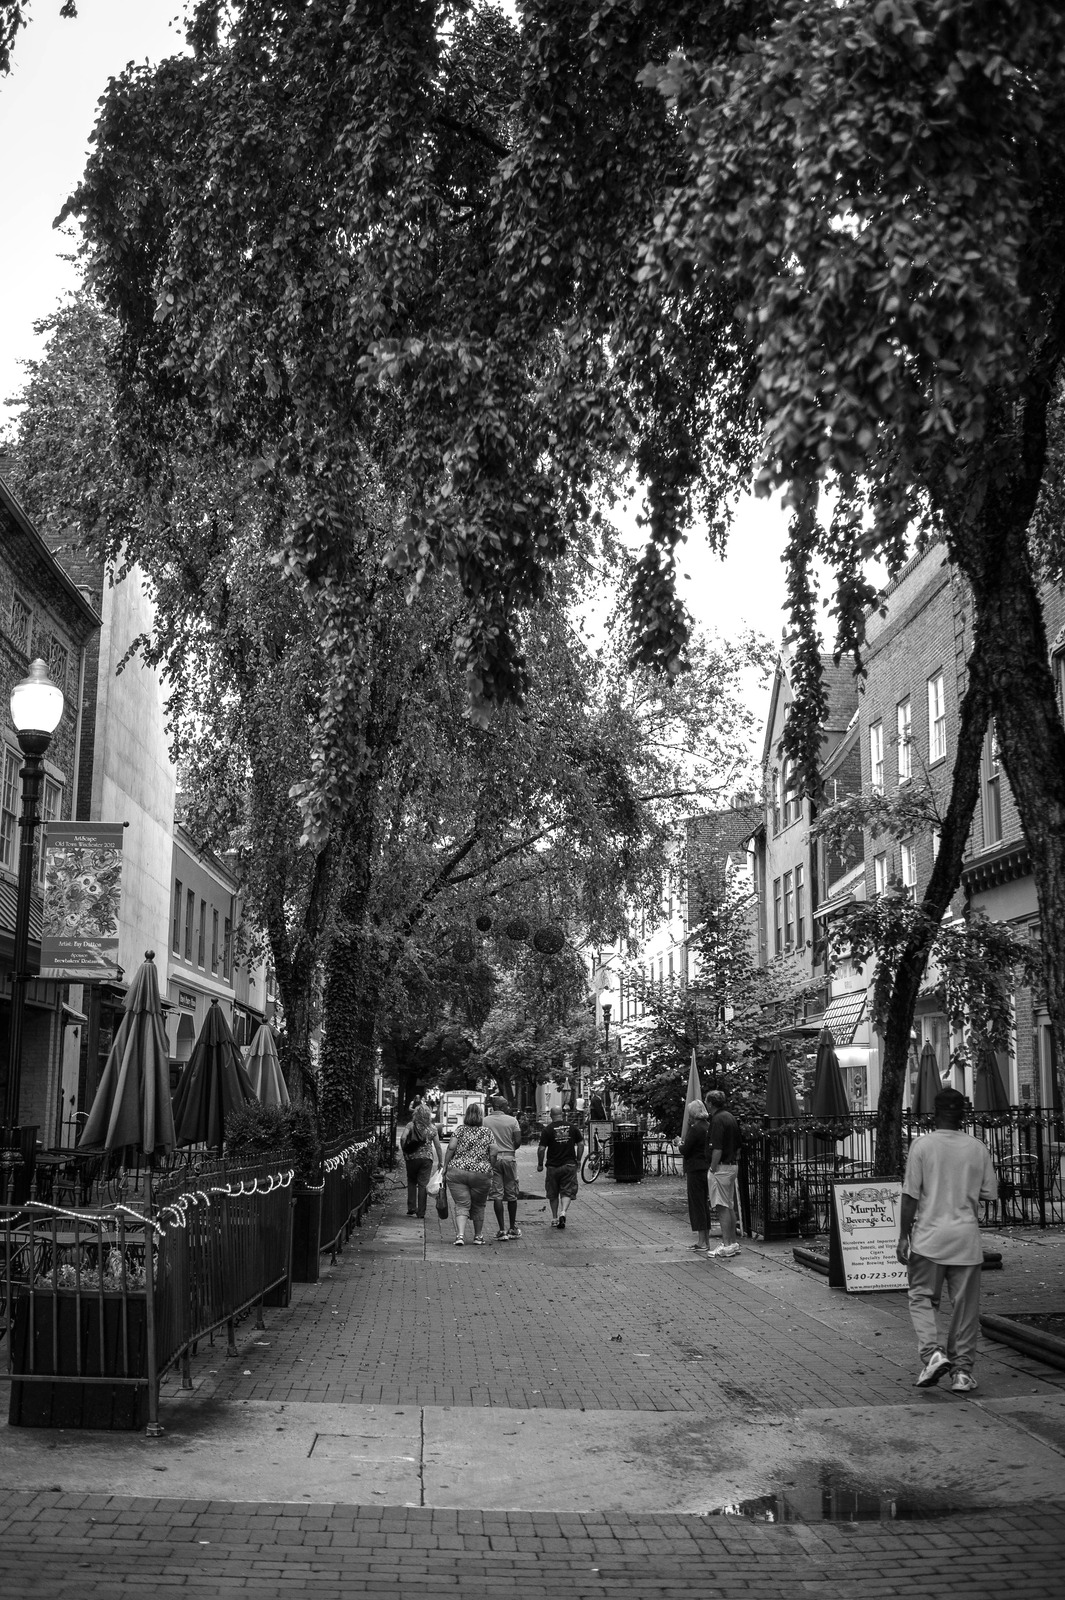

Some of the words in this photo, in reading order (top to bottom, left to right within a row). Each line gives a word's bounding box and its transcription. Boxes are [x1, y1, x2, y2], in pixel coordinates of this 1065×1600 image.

[849, 1204, 886, 1216] Murphy
[846, 1216, 879, 1227] Beverage
[881, 1213, 894, 1222] Co.
[846, 1272, 908, 1280] 540-723-971
